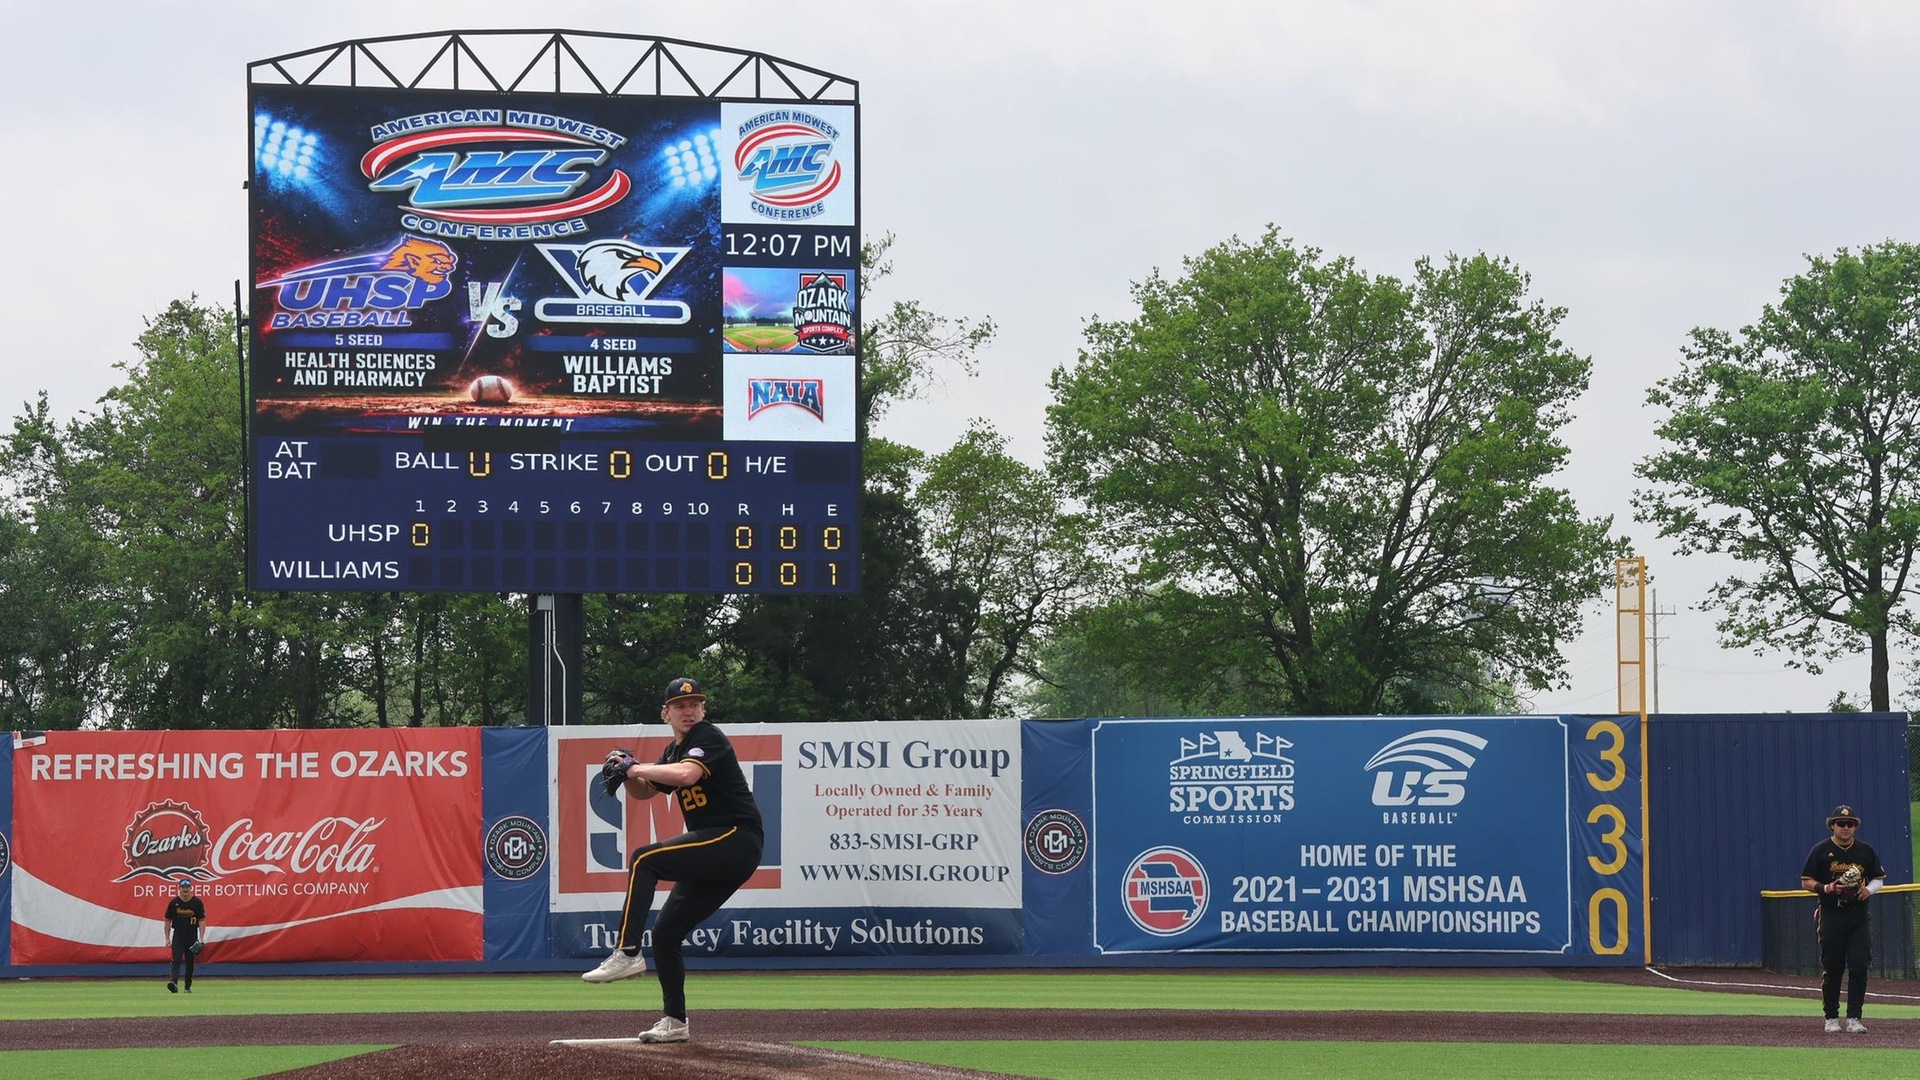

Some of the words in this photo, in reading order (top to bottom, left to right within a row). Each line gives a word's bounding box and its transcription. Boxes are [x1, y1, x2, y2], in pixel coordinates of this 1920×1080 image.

[371, 109, 501, 141] AMERICAN
[507, 110, 627, 148] MIDWEST
[739, 112, 789, 137] AMERICAN
[792, 111, 839, 139] MIDWEST
[369, 150, 606, 205] AMC
[739, 143, 831, 191] AMC
[751, 200, 825, 220] CONFERENCE
[401, 214, 588, 238] CONFERENCE
[725, 233, 802, 256] 12:07
[815, 235, 850, 257] PM
[279, 275, 451, 311] UHSP
[798, 287, 848, 312] OZARK
[272, 311, 413, 329] BASEBALL
[467, 281, 523, 338] VS
[577, 304, 652, 317] BASEBALL
[335, 334, 344, 346] 5
[348, 334, 383, 346] SEED
[802, 325, 821, 334] SPORTS
[822, 325, 844, 334] COMPLEX
[590, 338, 600, 351] 4
[603, 338, 637, 351] SEED
[285, 352, 350, 369] HEALTH
[356, 353, 436, 370] SCIENCES
[563, 356, 673, 375] WILLIAMS
[293, 369, 328, 386] AND
[334, 370, 427, 387] PHARMACY
[573, 374, 663, 394] BAPTIST
[751, 380, 822, 412] NAIA
[275, 441, 308, 458] AT
[267, 462, 317, 479] BAT
[395, 452, 459, 469] BALL
[510, 453, 598, 470] STRIKE
[610, 450, 631, 479] 0
[646, 455, 699, 472] OUT
[708, 451, 728, 479] 0
[745, 456, 787, 474] H/E
[416, 500, 425, 512] 1
[447, 500, 456, 513] 2
[478, 500, 488, 513] 3
[508, 501, 519, 513] 4
[540, 501, 550, 514] 5
[570, 502, 581, 514] 6
[601, 502, 611, 514] 7
[632, 502, 642, 514] 8
[663, 502, 673, 515] 9
[688, 503, 709, 515] 10
[738, 503, 750, 516] R
[782, 504, 794, 516] H
[828, 504, 837, 516] E
[328, 523, 399, 542] UHSP
[412, 523, 429, 546] 0
[735, 526, 752, 549] 0
[780, 526, 797, 549] 0
[824, 527, 841, 550] 0
[270, 560, 400, 579] WILLIAMS
[735, 562, 752, 585] 0
[780, 562, 797, 586] 0
[829, 563, 837, 586] 1
[31, 752, 243, 781] REFRESHING
[256, 751, 319, 779] THE
[330, 750, 469, 778] OZARKS
[798, 740, 891, 769] SMSI
[902, 740, 1010, 777] Group
[1169, 764, 1294, 782] SPRINGFIELD
[682, 785, 708, 812] 26
[814, 784, 866, 799] Locally
[870, 784, 921, 797] Owned
[926, 784, 939, 797] &
[945, 784, 994, 800] Family
[1169, 786, 1295, 813] SPORTS
[1371, 771, 1468, 806] US
[826, 804, 892, 819] Operated
[897, 804, 918, 817] for
[922, 804, 939, 817] 35
[944, 804, 983, 817] Years
[1183, 814, 1282, 824] COMMISSION
[490, 823, 508, 844] OZARK
[510, 821, 542, 843] MOUNTAIN
[1030, 816, 1048, 837] OZARK
[1050, 814, 1082, 837] MOUNTAIN
[131, 825, 201, 857] Ozarks
[829, 833, 979, 850] 833-SMSI-GRP
[516, 851, 543, 876] COMPLEX
[1300, 845, 1367, 868] HOME
[1375, 845, 1404, 867] OF
[1412, 845, 1457, 867] THE
[799, 864, 1010, 882] WWW.SMSI.GROUP
[134, 886, 153, 898] DR
[159, 885, 211, 898] PEER
[215, 884, 288, 897] BOTTLING
[293, 882, 370, 896] COMPANY
[1140, 880, 1192, 897] MSHSAA
[1404, 876, 1527, 903] MSHSAA
[1221, 910, 1339, 934] BASEBALL
[1347, 910, 1541, 934] CHAMPIONSHIPS
[733, 919, 841, 951] Facility
[851, 917, 984, 946] Solutions
